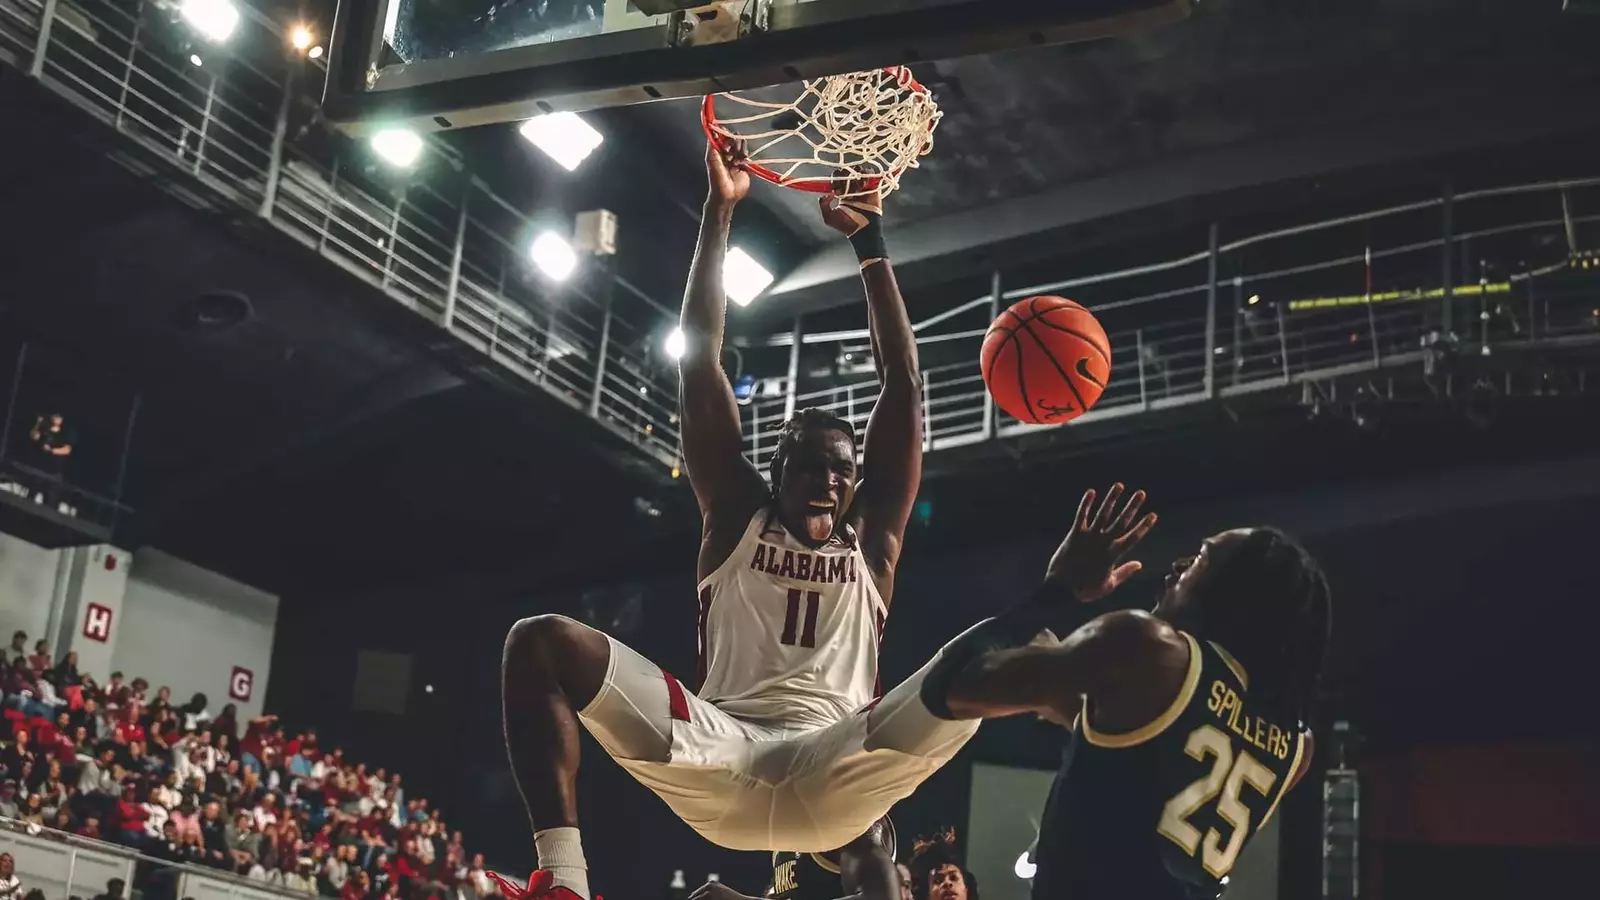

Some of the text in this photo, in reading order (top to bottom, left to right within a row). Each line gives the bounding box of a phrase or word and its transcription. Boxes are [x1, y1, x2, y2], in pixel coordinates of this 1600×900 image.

[86, 607, 109, 637] H
[780, 588, 820, 649] 11
[232, 672, 250, 697] G
[1207, 680, 1291, 760] SPILLERS
[1157, 724, 1277, 879] 25
[775, 860, 798, 895] WAKE
